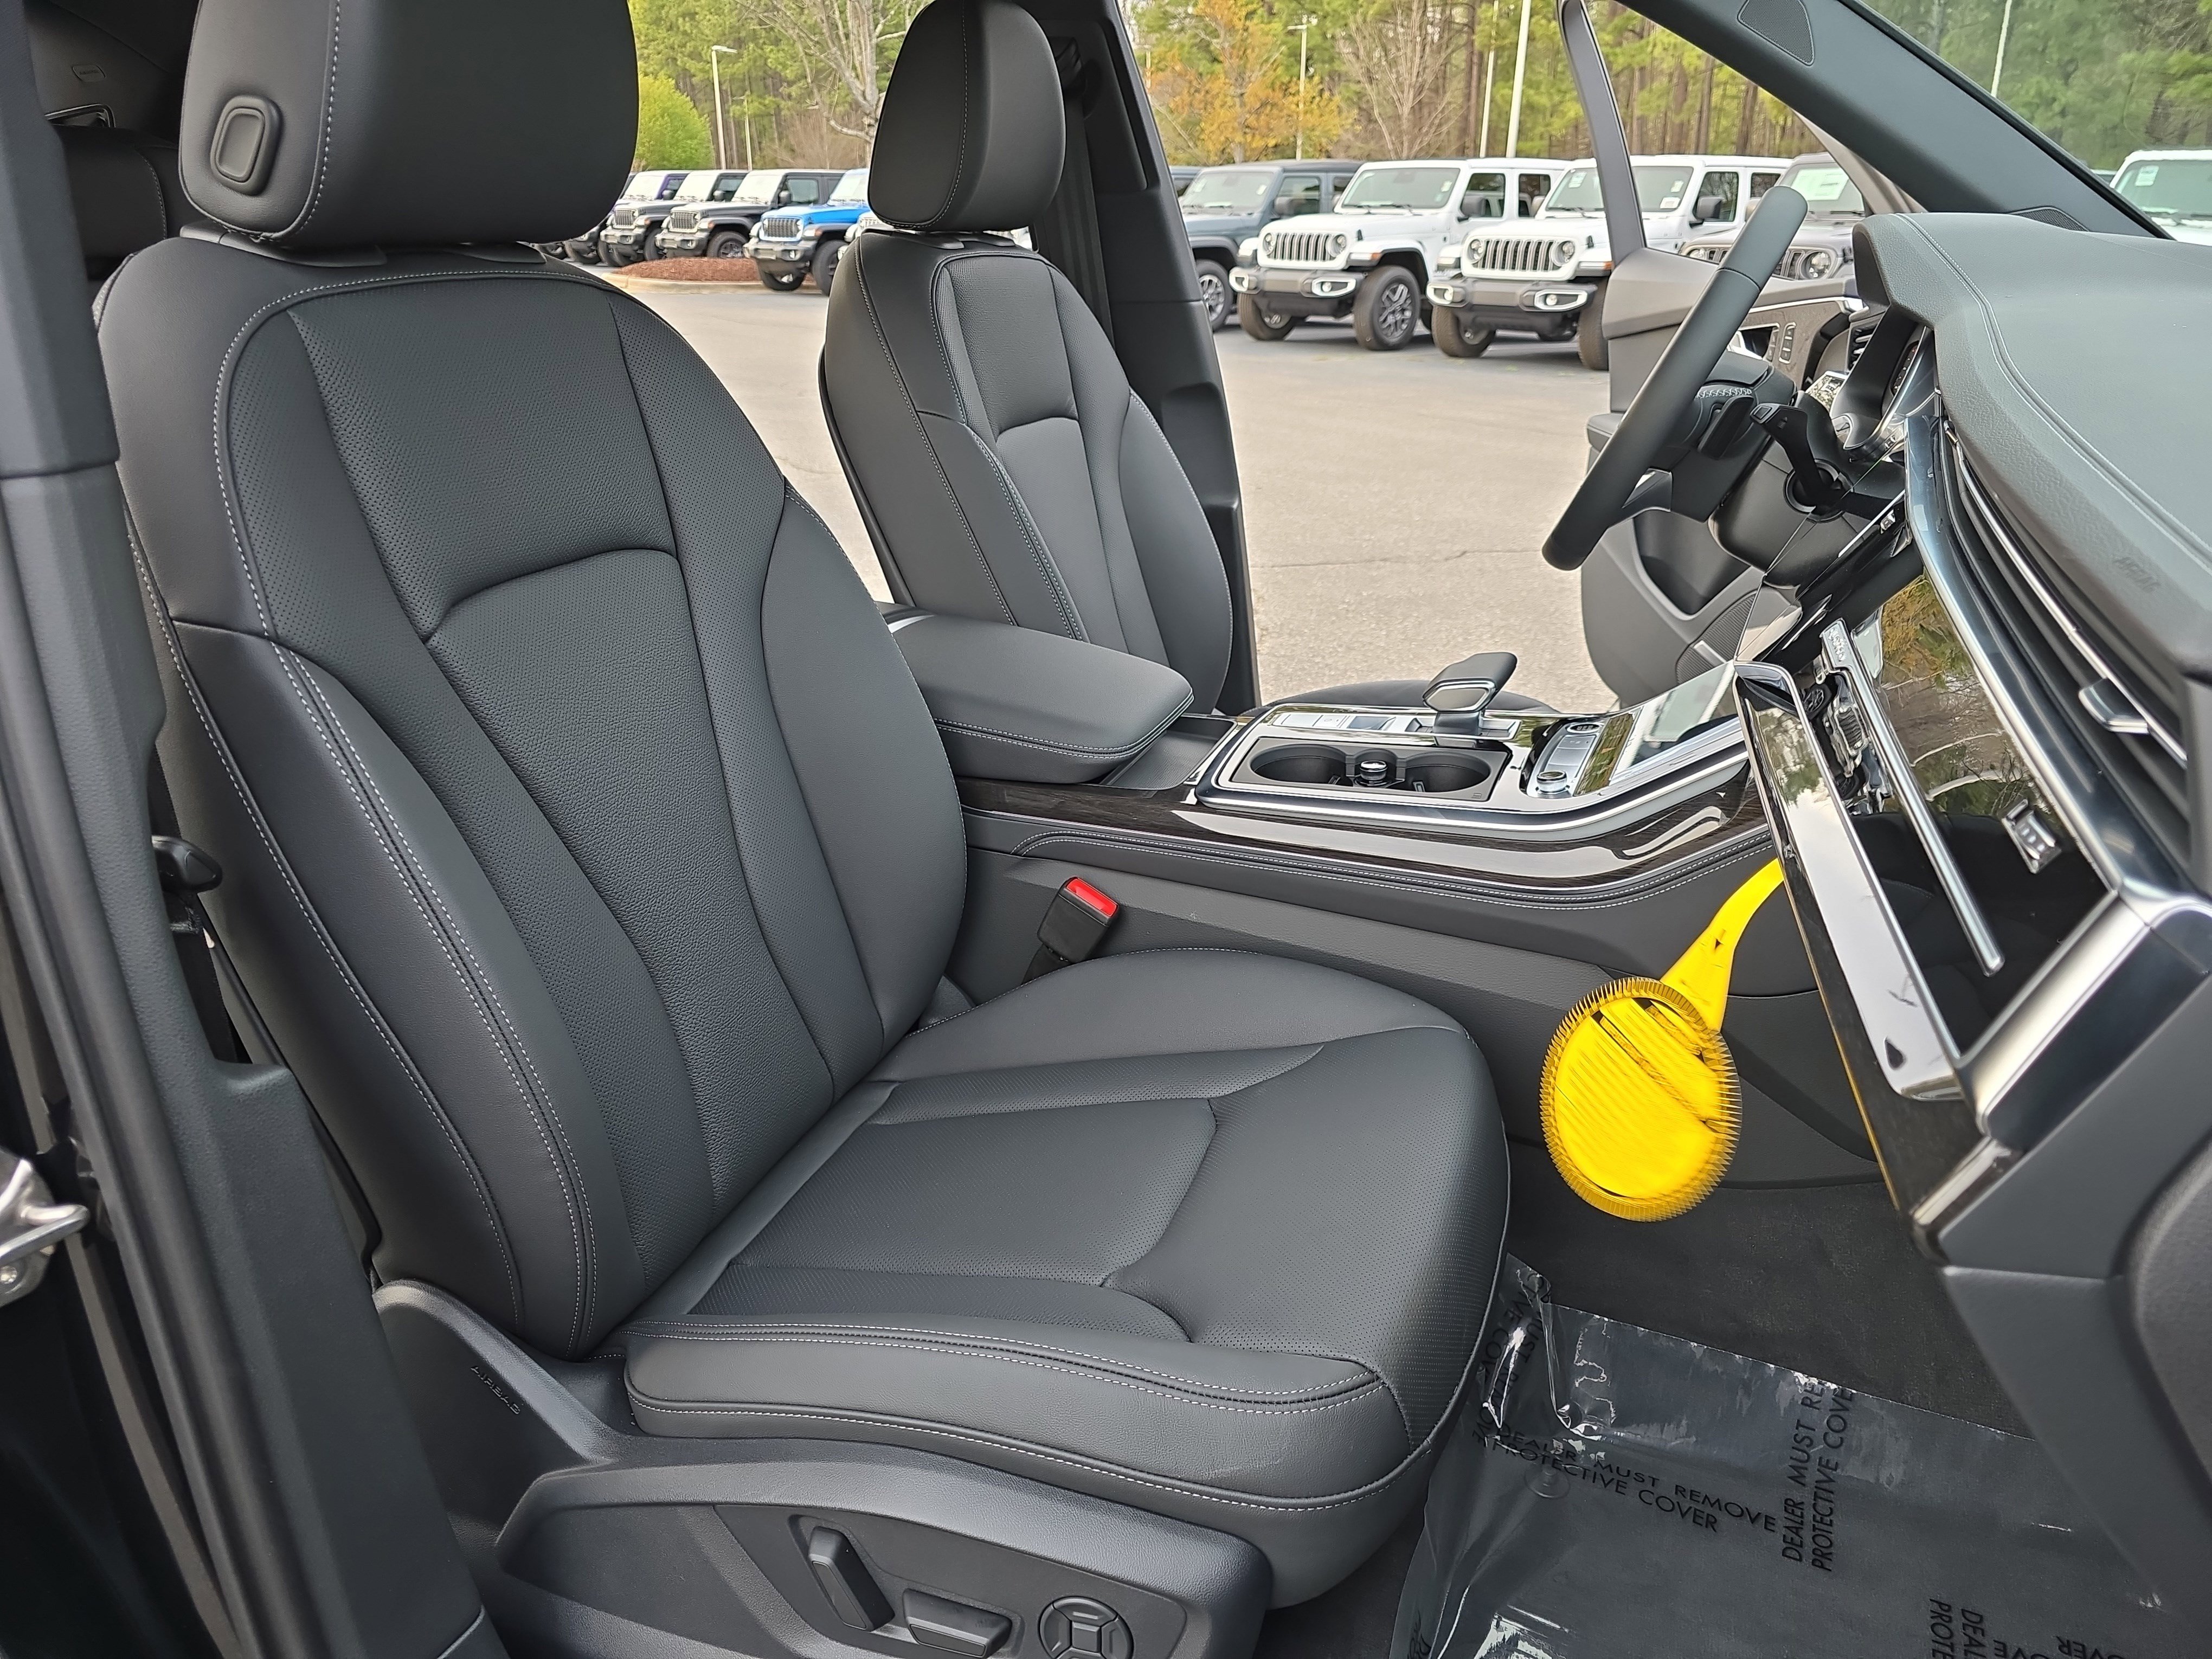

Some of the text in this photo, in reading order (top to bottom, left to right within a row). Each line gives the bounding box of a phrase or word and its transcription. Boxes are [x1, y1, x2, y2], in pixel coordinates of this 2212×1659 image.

[1491, 1437, 1718, 1533] PROTECTIVE COVER
[1787, 1418, 1817, 1487] MUST
[1593, 1460, 1660, 1487] MUST
[1674, 1484, 1776, 1533] REMOVE
[1782, 1497, 1805, 1562] DEALER
[1811, 1456, 1839, 1572] PROTECTIVE
